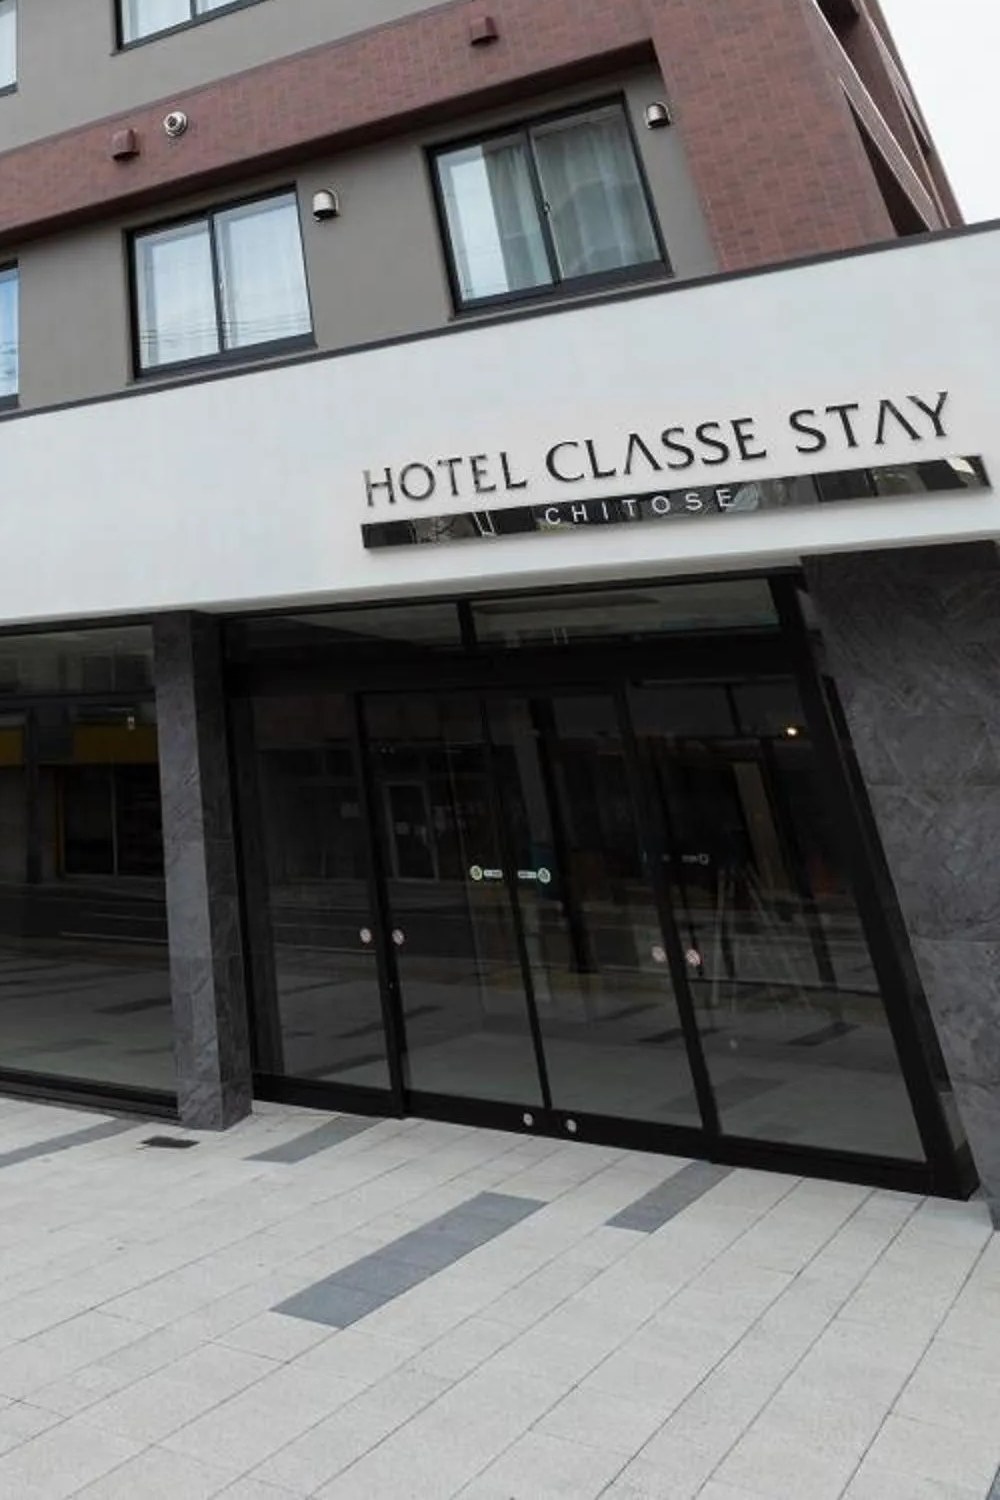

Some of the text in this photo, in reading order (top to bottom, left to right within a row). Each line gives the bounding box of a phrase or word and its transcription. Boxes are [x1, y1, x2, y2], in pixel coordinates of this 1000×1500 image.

[363, 392, 949, 506] HOTEL CLASSE STAY
[545, 489, 735, 525] CHITOSE
